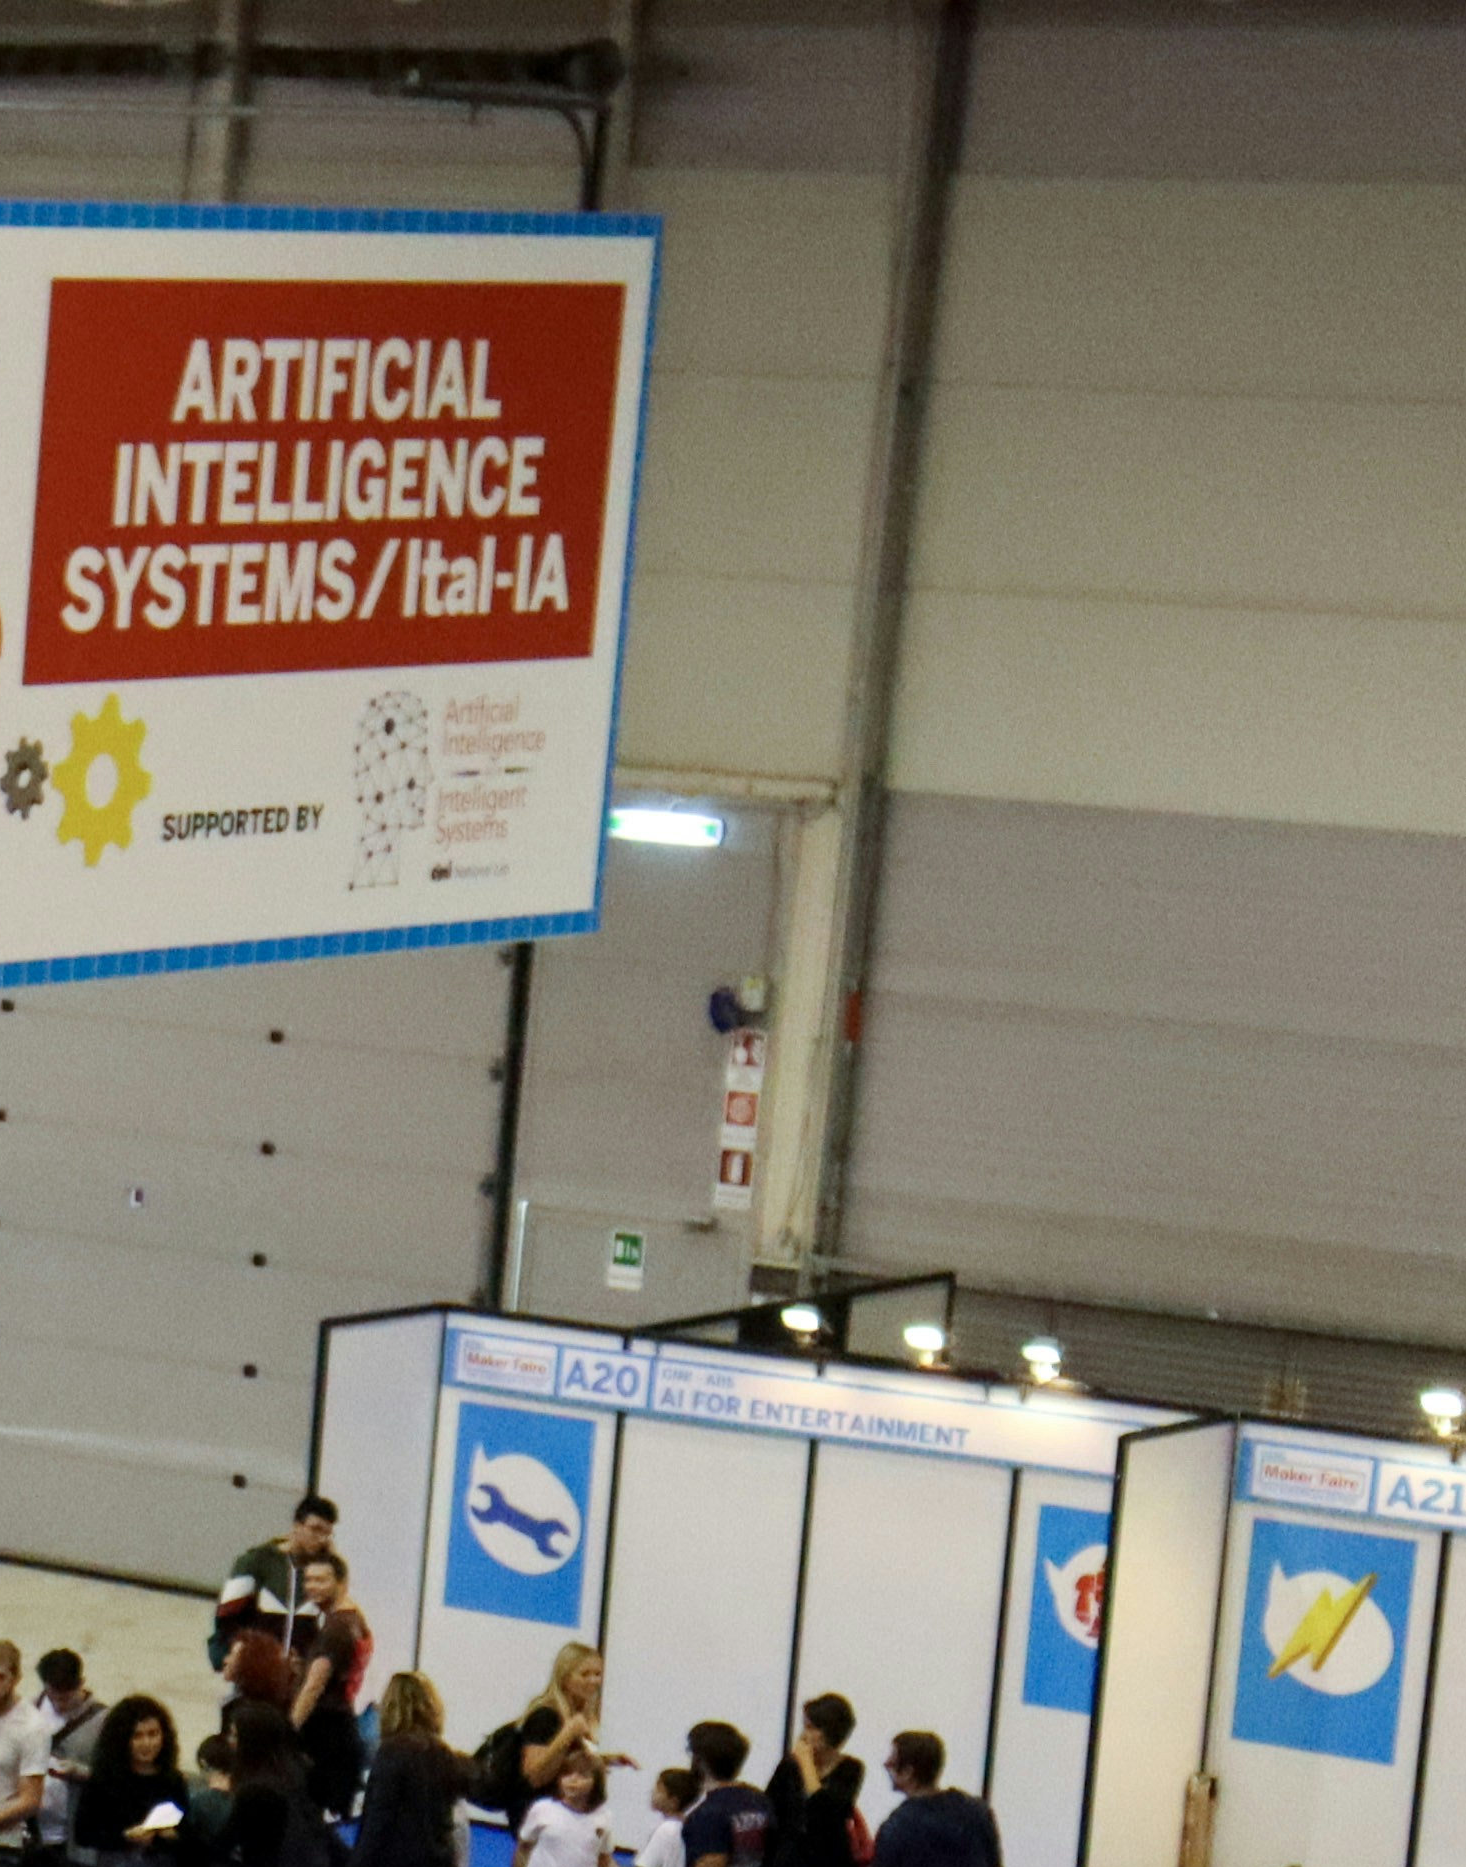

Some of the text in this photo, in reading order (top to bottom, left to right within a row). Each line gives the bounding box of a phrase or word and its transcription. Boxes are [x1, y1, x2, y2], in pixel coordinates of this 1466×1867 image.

[172, 337, 501, 423] ARTIFICIAL
[112, 437, 546, 527] INTELLIGENCE
[445, 694, 520, 724] Artificial
[444, 727, 546, 760] Intelligence
[437, 783, 527, 816] Intelligent
[162, 804, 324, 842] SUPPORTED BY
[435, 814, 509, 850] Systems
[564, 1357, 640, 1400] A20
[661, 1388, 970, 1449] AI FOR ENTERTAINMENT
[1263, 1464, 1360, 1491] Maker Faire
[1386, 1473, 1465, 1516] A21
